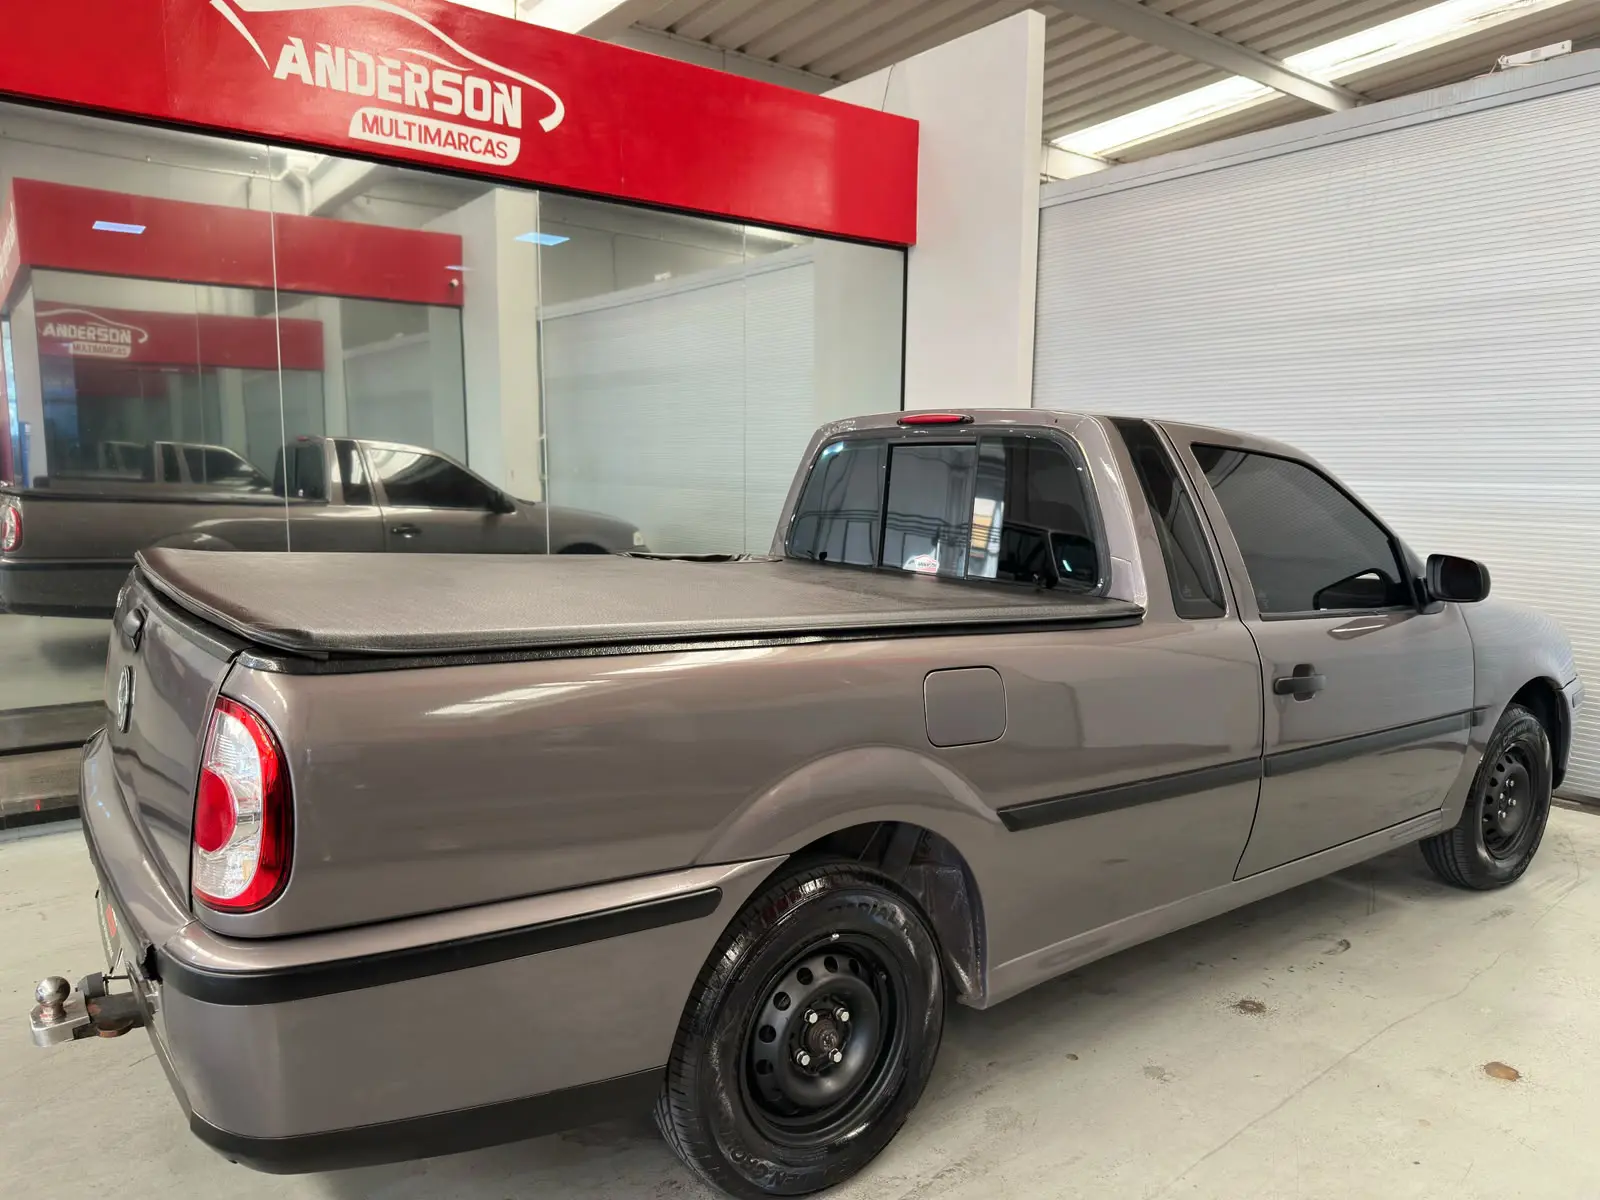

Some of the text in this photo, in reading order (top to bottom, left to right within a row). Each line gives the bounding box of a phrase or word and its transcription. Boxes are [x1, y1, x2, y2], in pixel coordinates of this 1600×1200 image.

[273, 36, 522, 129] ANDERSON
[361, 112, 509, 159] MULTIMARCAS
[42, 323, 131, 343] ANDERSON
